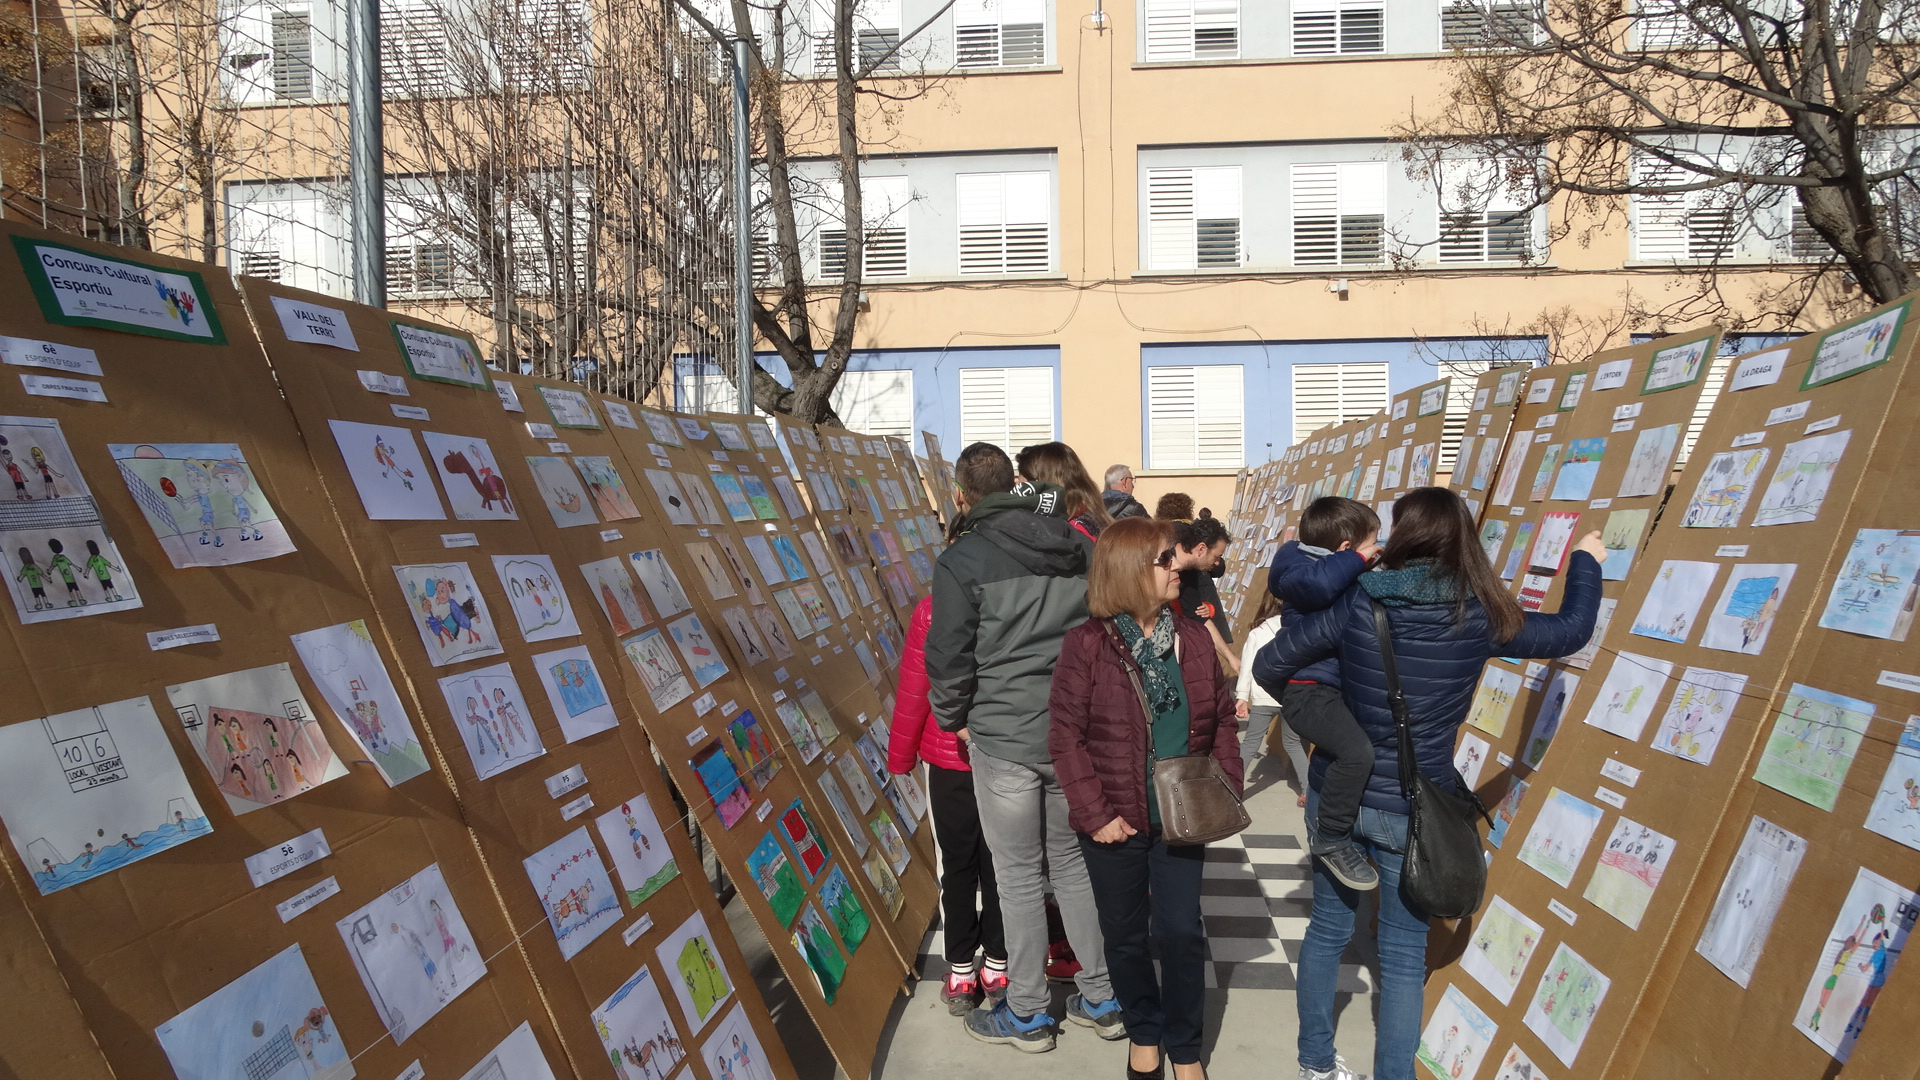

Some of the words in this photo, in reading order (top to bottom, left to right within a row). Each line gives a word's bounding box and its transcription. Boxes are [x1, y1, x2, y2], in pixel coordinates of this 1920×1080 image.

[42, 254, 103, 275] Concurs
[103, 265, 152, 286] Cultural
[51, 276, 112, 296] Esportiu
[293, 309, 318, 322] VALL
[318, 314, 336, 327] DEL
[306, 324, 336, 339] TERRI
[400, 329, 430, 344] Concurs
[429, 336, 453, 348] Cultural
[42, 344, 57, 354] 6è
[406, 345, 436, 359] Esportiu
[25, 354, 56, 365] ESPORTS
[56, 358, 81, 369] D'EQUIP
[1741, 369, 1749, 378] LA
[1749, 364, 1772, 376] DRAGA
[63, 745, 82, 763] 10
[94, 737, 106, 758] 6
[69, 768, 88, 780] LOCAL
[281, 844, 295, 856] 5è
[269, 859, 295, 875] ESPORTS
[294, 850, 314, 864] D'EQUIP
[291, 898, 306, 909] OBRES
